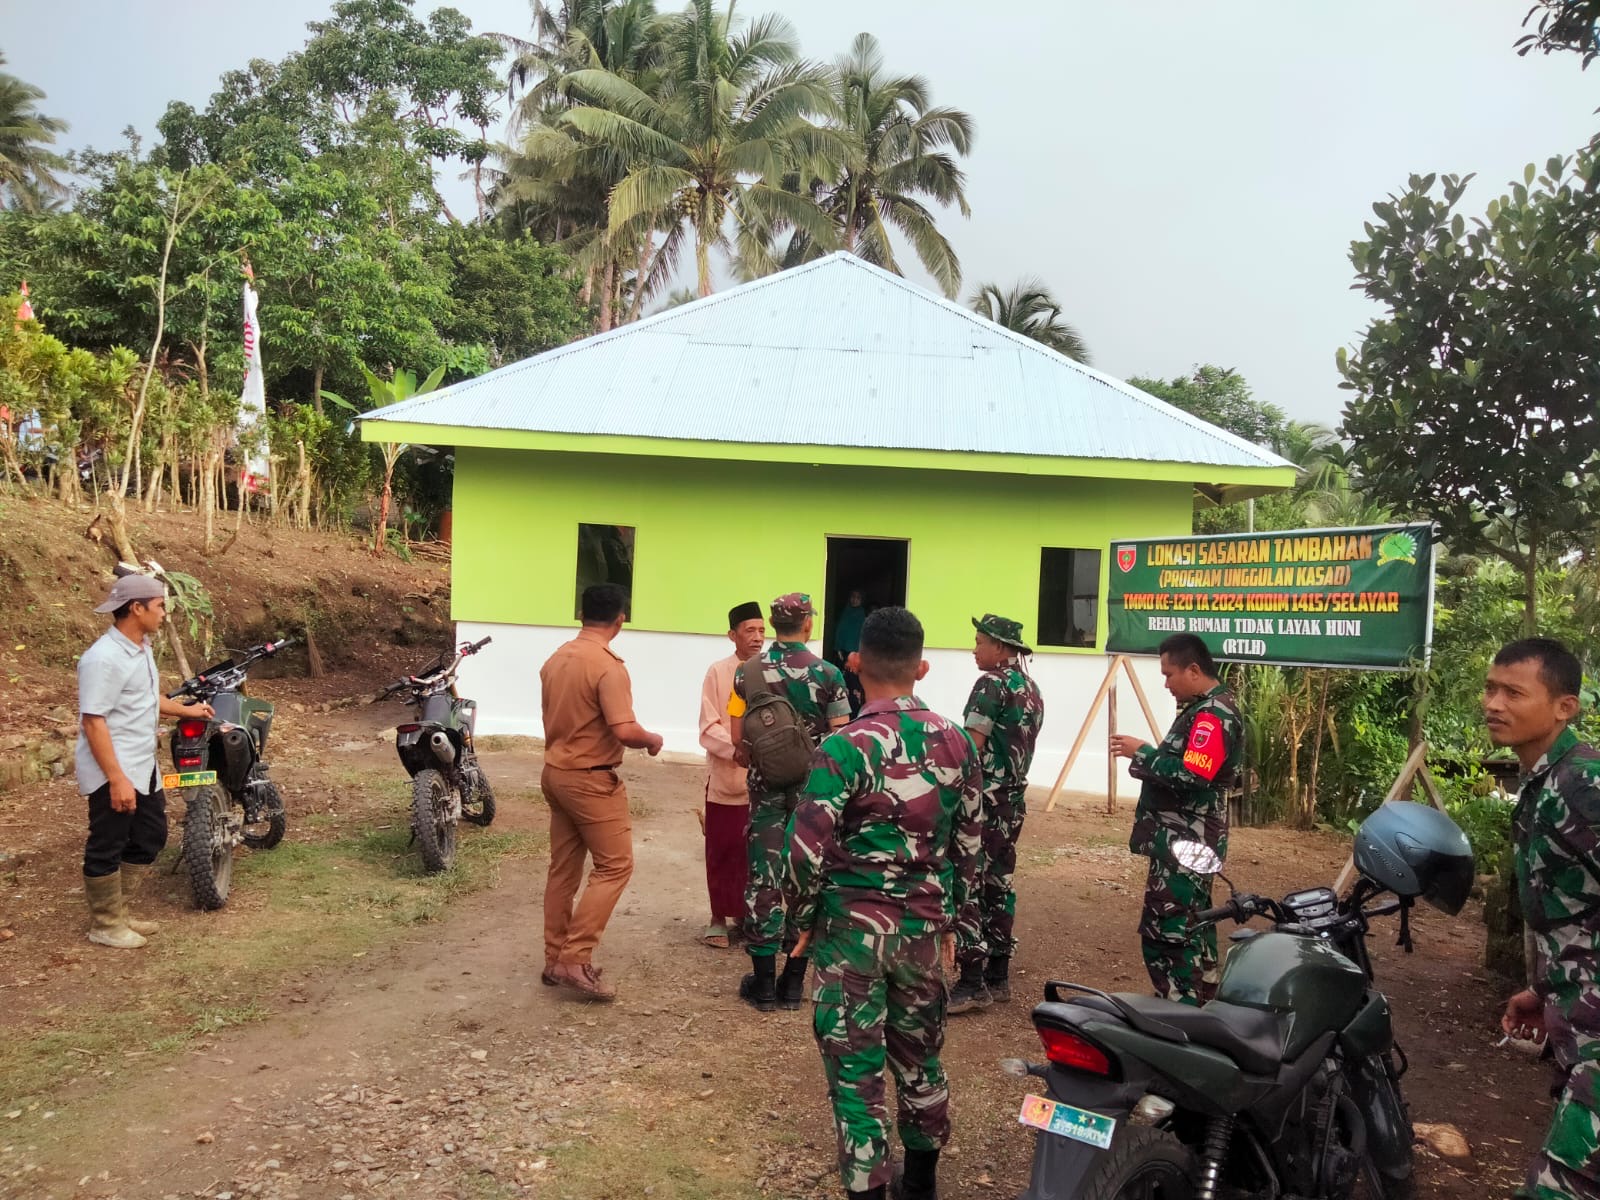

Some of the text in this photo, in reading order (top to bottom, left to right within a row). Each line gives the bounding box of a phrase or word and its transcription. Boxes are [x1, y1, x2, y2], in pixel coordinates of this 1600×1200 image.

[1147, 535, 1373, 567] LOKASI SASARAN TAMBAHAN
[1159, 565, 1352, 588] (PROGRAM UNGGULAN KASAD)
[1123, 592, 1400, 613] TMMD KE-120 TA 2024 KODIM 1415/SELAYAR
[1148, 616, 1361, 636] REHAB RUMAH TIDAK LAYAK HUNI
[1222, 638, 1267, 656] (RTLH)
